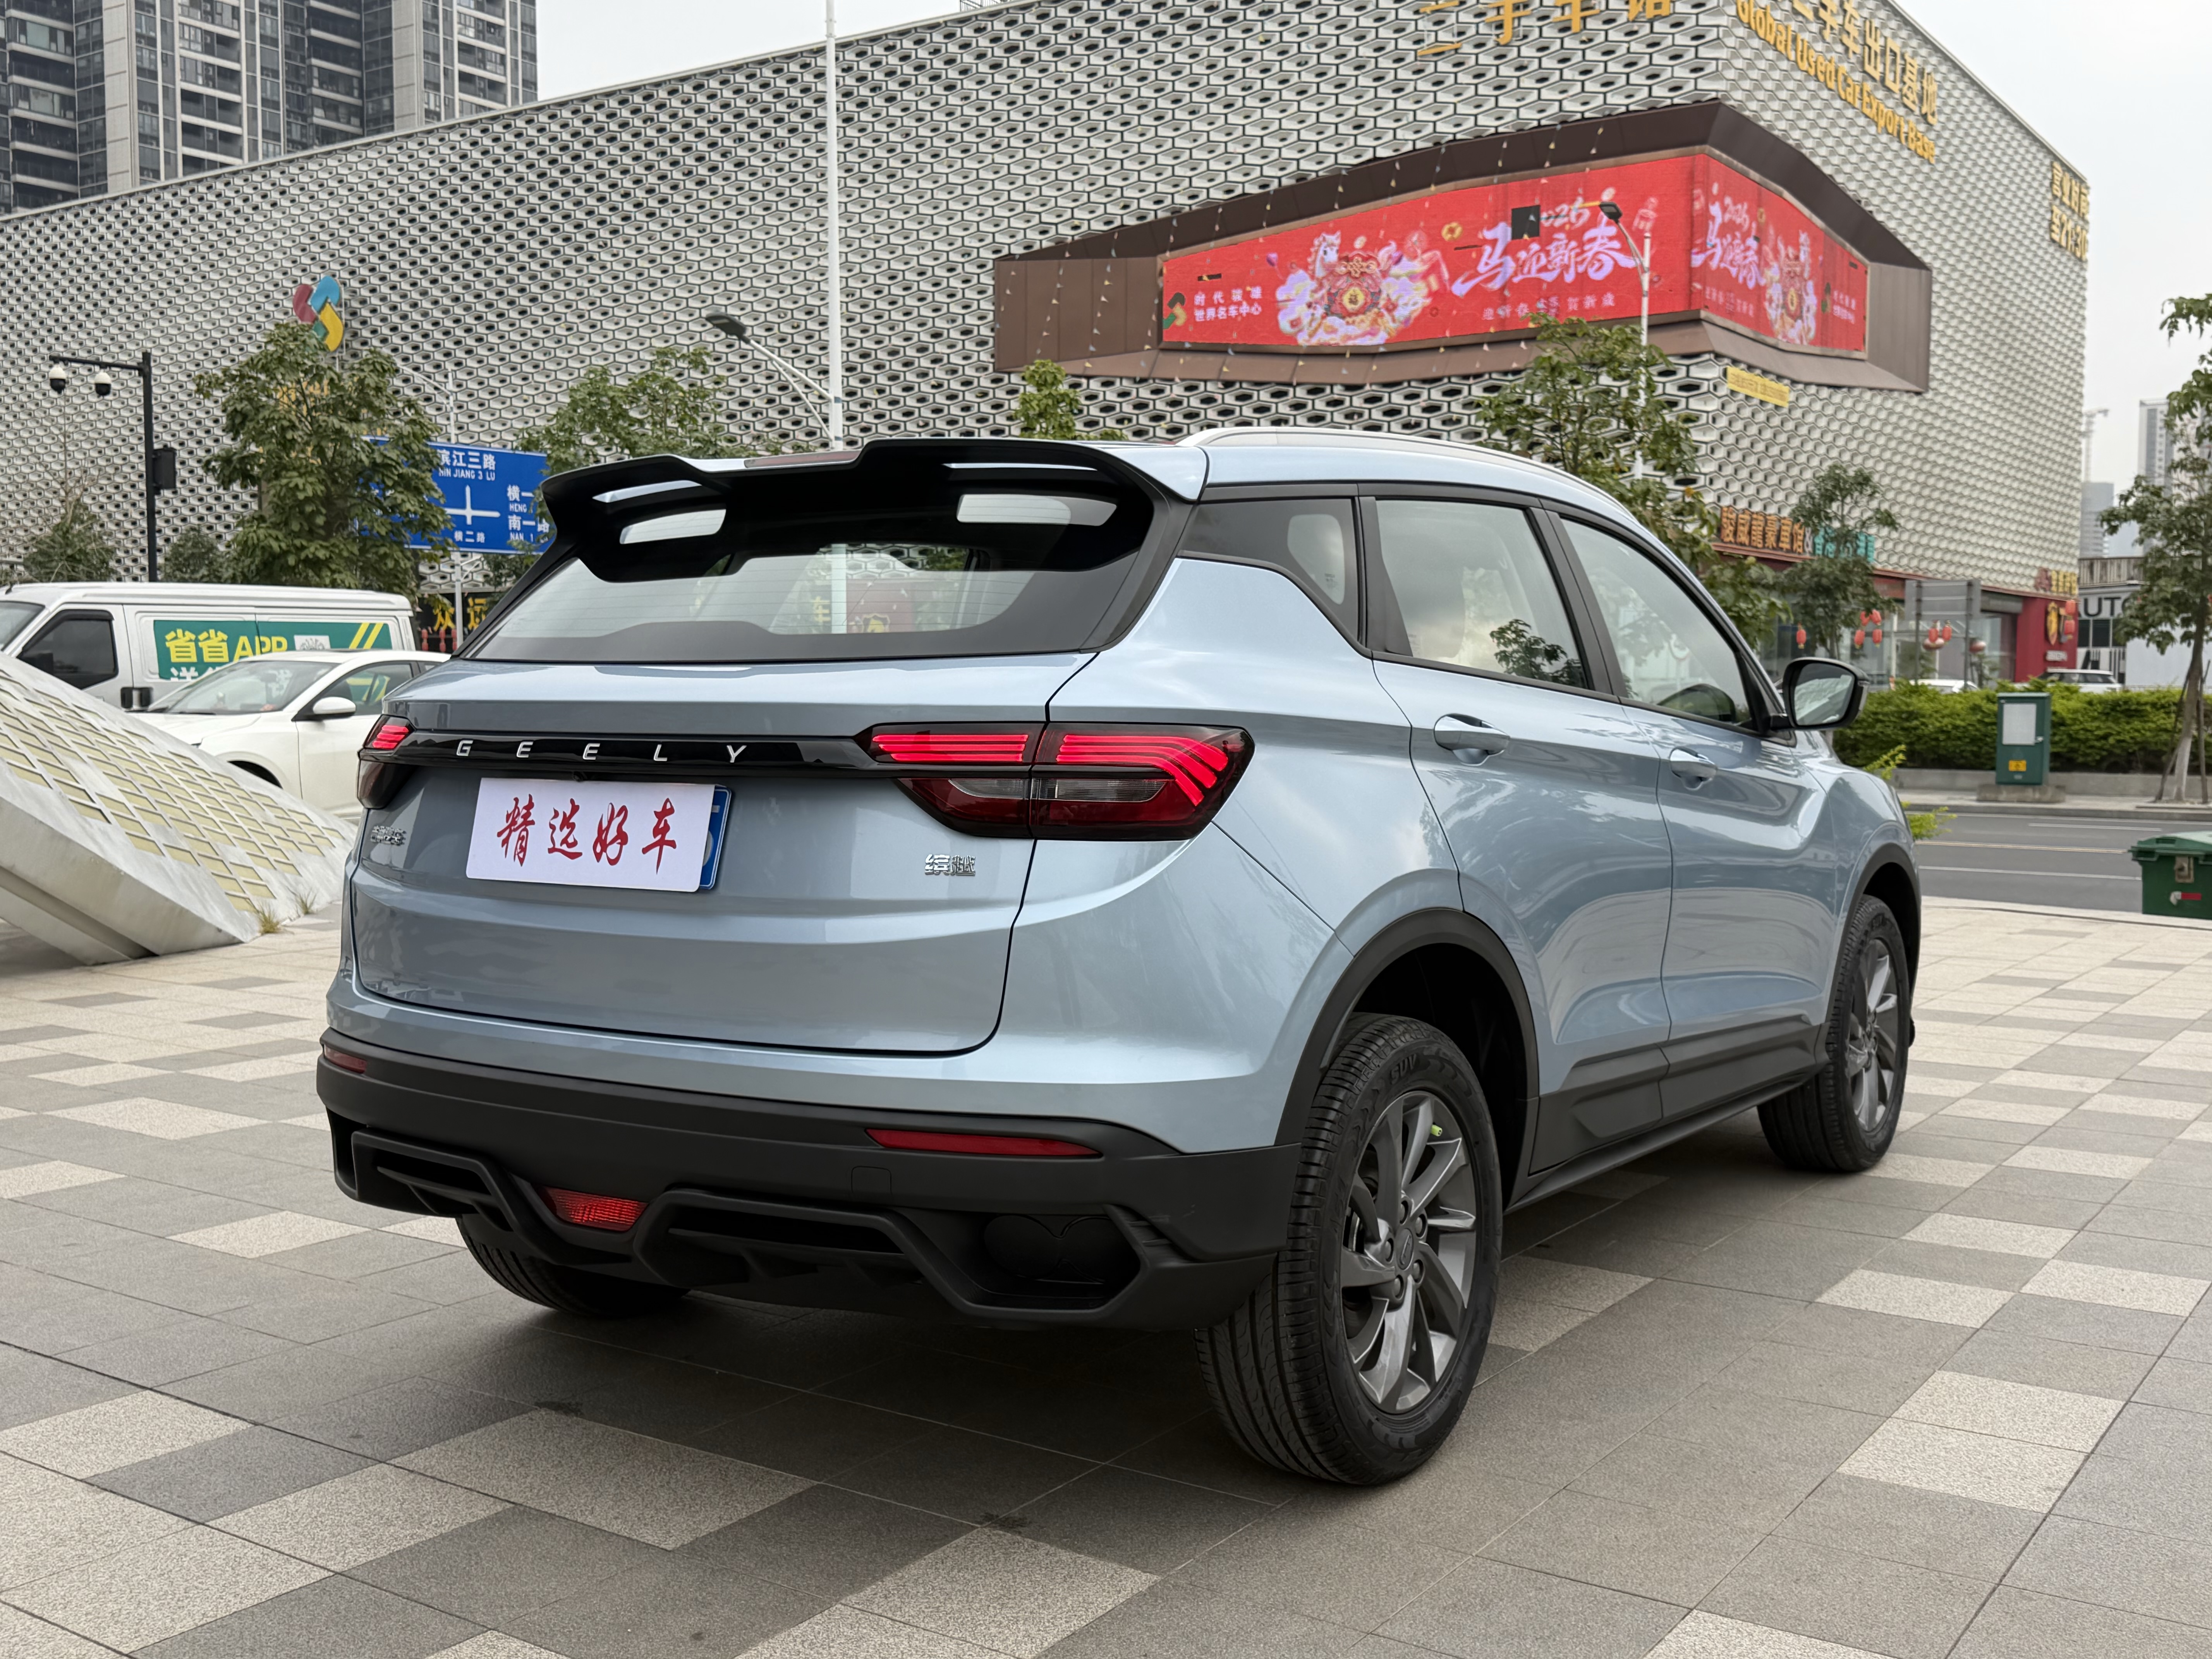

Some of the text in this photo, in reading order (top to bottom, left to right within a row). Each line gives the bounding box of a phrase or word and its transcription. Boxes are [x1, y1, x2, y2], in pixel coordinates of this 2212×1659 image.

[1736, 0, 1935, 164] Global Used Car Export Base
[1540, 197, 1590, 229] 026
[453, 469, 476, 479] JIANG
[478, 471, 483, 480] 3
[486, 472, 496, 481] LU
[510, 503, 527, 513] HENG
[454, 530, 485, 543] 横二路
[2078, 597, 2128, 617] UT
[456, 740, 747, 763] GEELY
[496, 793, 677, 875] 精选好车
